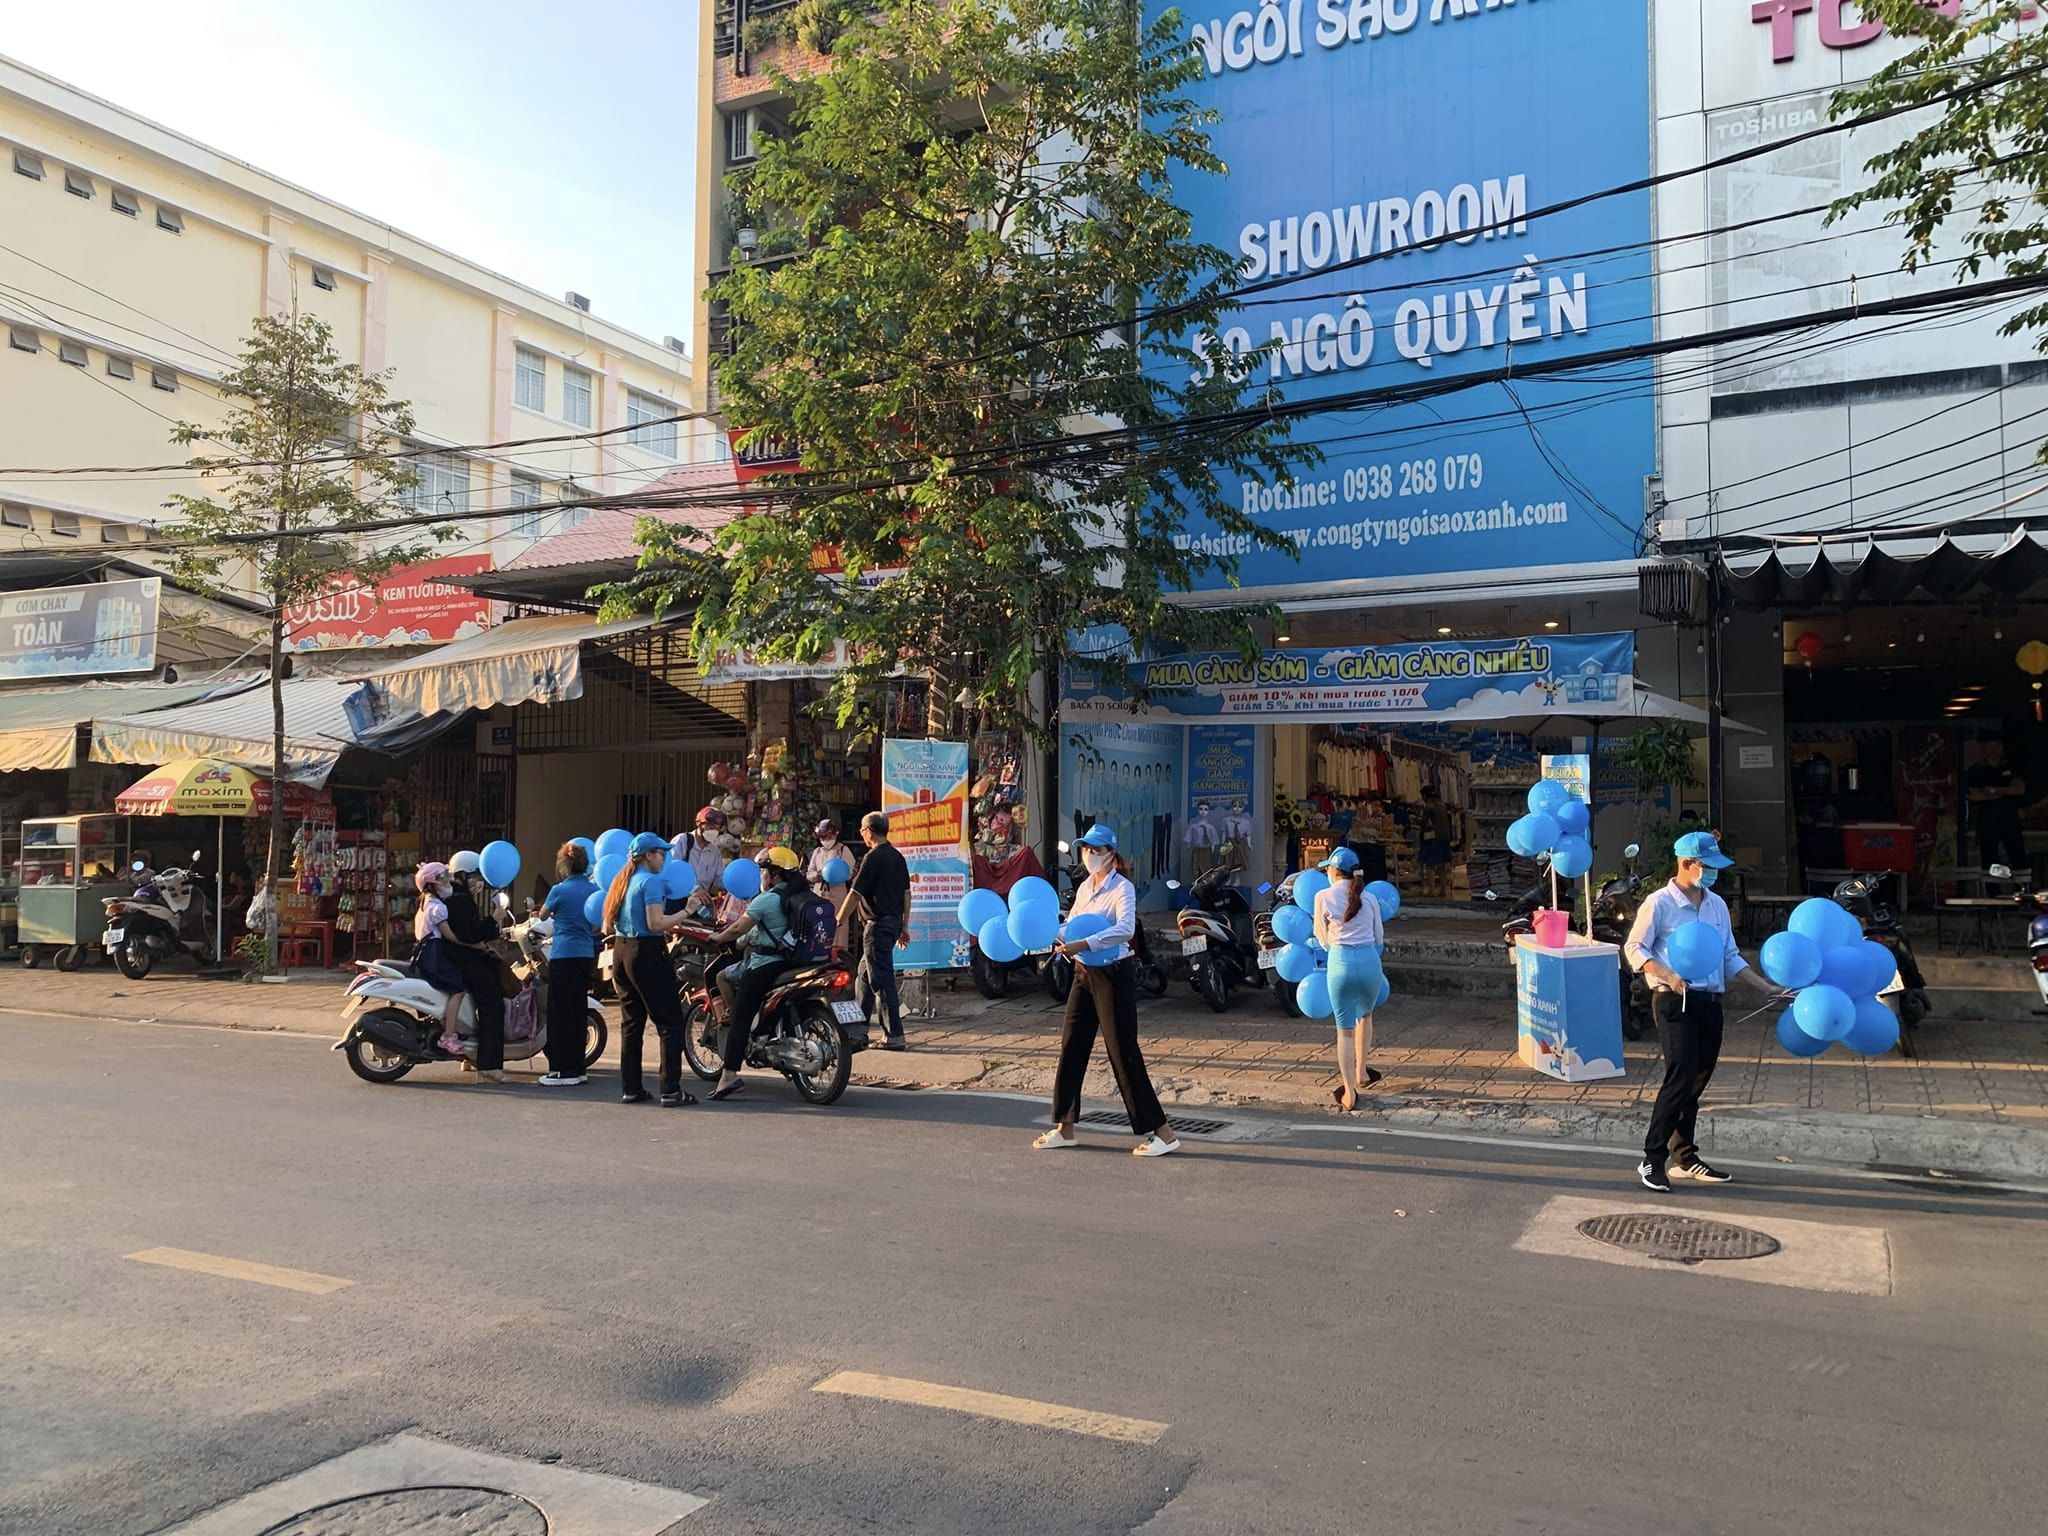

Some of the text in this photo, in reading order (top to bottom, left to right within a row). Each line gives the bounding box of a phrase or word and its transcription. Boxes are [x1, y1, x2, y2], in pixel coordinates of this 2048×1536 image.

[1714, 108, 1818, 139] TOSHIBA
[1239, 174, 1528, 282] SHOWROOM
[1270, 294, 1376, 379] NGÔ
[1394, 254, 1588, 368] QUYỀN
[1242, 452, 1483, 514] Hotline: 0938 268 079
[40, 597, 69, 611] CHAY
[383, 587, 405, 601] KEM
[407, 584, 433, 599] TƯƠI
[12, 617, 63, 647] TOÀN
[1148, 662, 1193, 686] MUA
[1196, 655, 1254, 684] CÀNG
[1257, 653, 1306, 682] SỚM
[1338, 650, 1398, 679] GIẢM
[1403, 648, 1470, 678] CÀNG
[1070, 701, 1093, 710] BACK
[1095, 701, 1106, 710] TO
[1264, 690, 1294, 701] 10%
[1299, 690, 1319, 699] Khi
[1323, 690, 1349, 699] mua
[1354, 688, 1386, 699] trước
[1391, 687, 1419, 697] 10/6
[1266, 700, 1289, 710] 5%
[1294, 700, 1313, 709] Khi
[1317, 700, 1344, 709] mua
[1349, 698, 1381, 709] trước
[1385, 697, 1413, 707] 11/7
[181, 786, 244, 797] maxim
